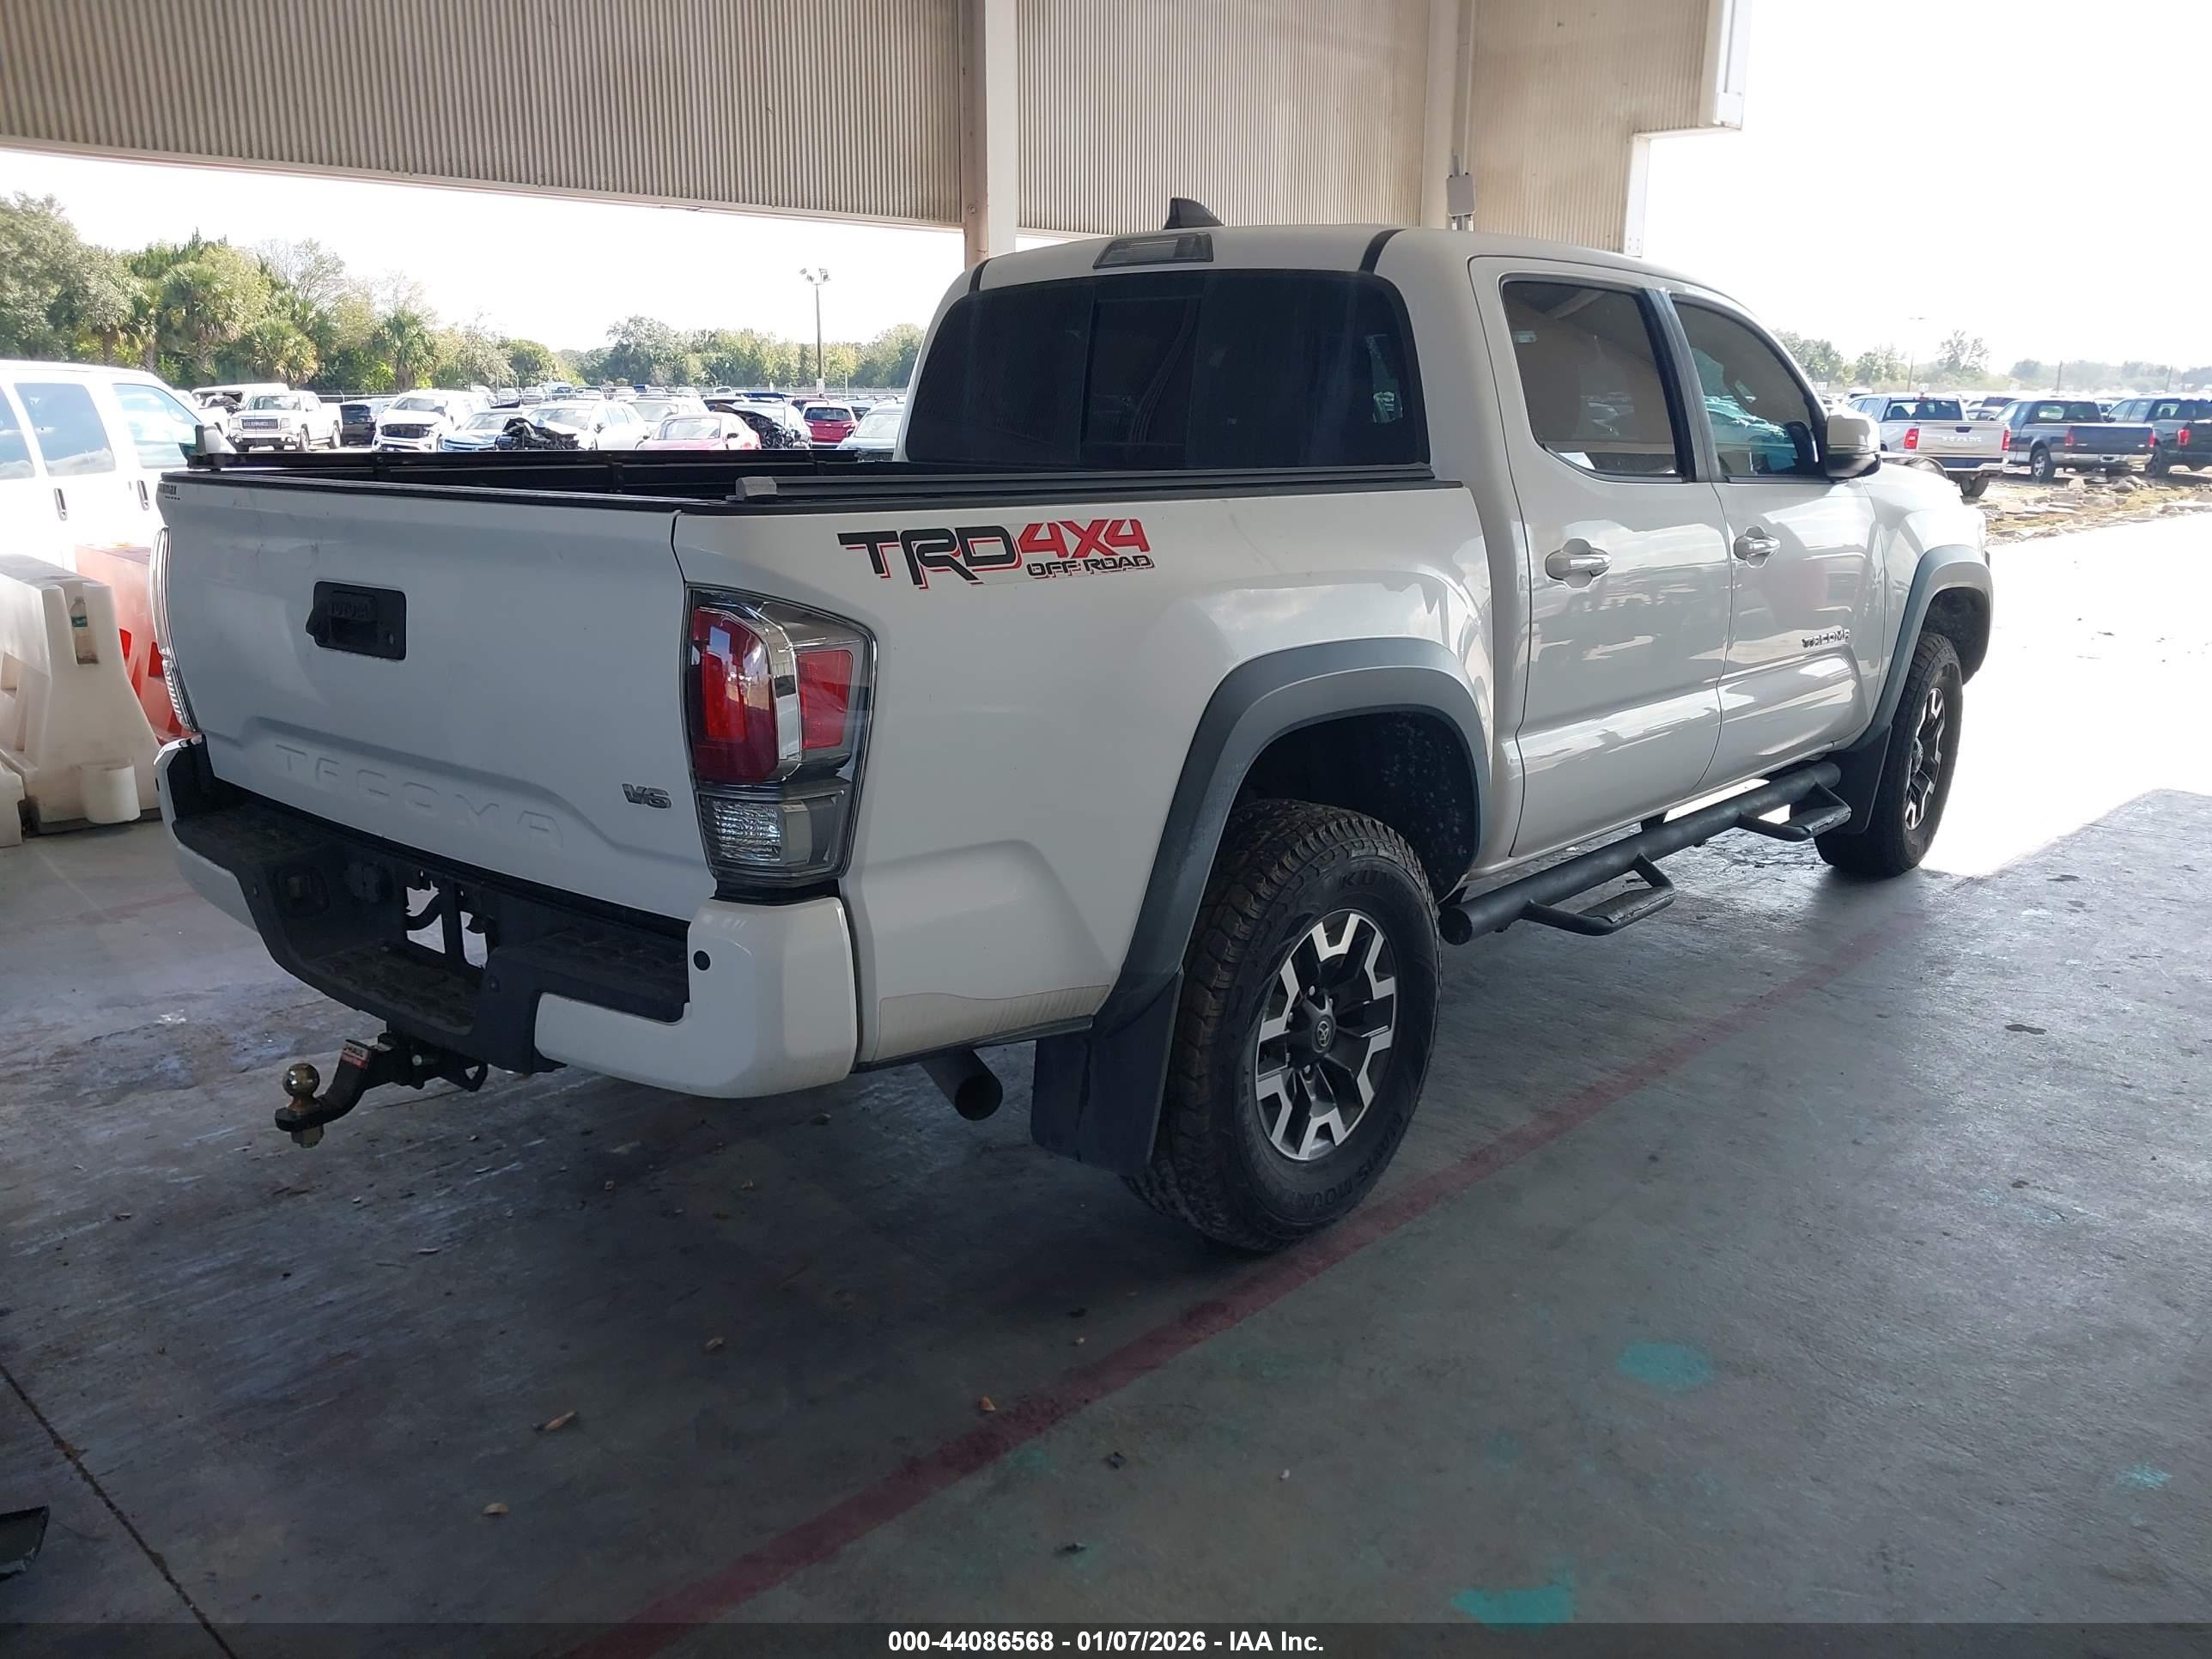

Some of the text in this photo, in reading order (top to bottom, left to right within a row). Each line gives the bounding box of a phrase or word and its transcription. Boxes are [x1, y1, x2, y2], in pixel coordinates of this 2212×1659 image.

[837, 519, 1152, 589] TRD 4X4
[1027, 555, 1154, 579] OFF ROAD
[622, 783, 672, 809] V6
